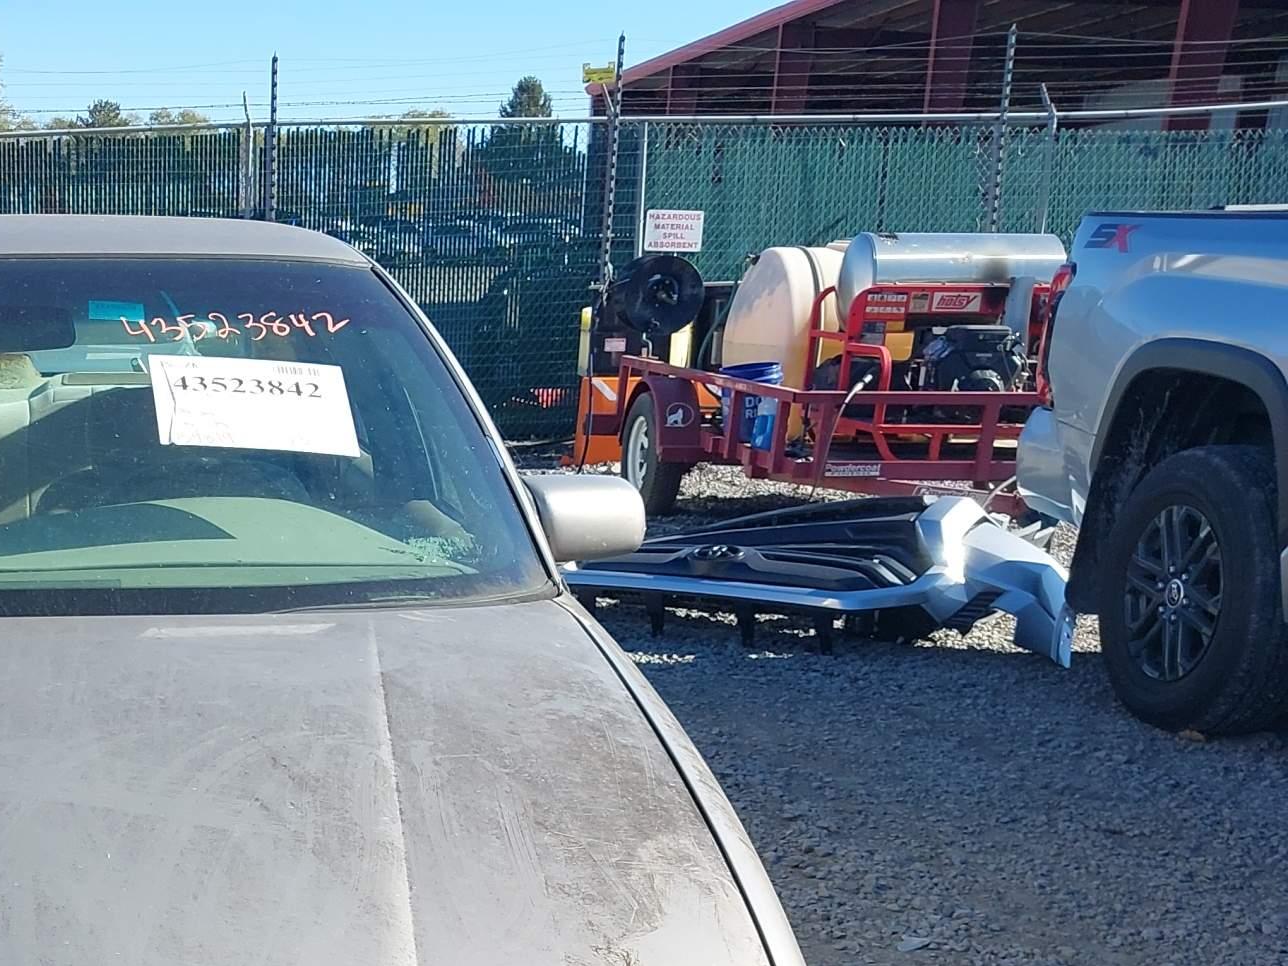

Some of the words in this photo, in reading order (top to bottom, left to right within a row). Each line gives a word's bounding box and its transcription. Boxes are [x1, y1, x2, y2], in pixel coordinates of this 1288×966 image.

[649, 213, 701, 221] HAZARDOUS
[663, 232, 685, 240] SPILL
[648, 241, 698, 249] ABSORBENT
[120, 312, 351, 342] 43523842
[173, 375, 323, 399] 43523842
